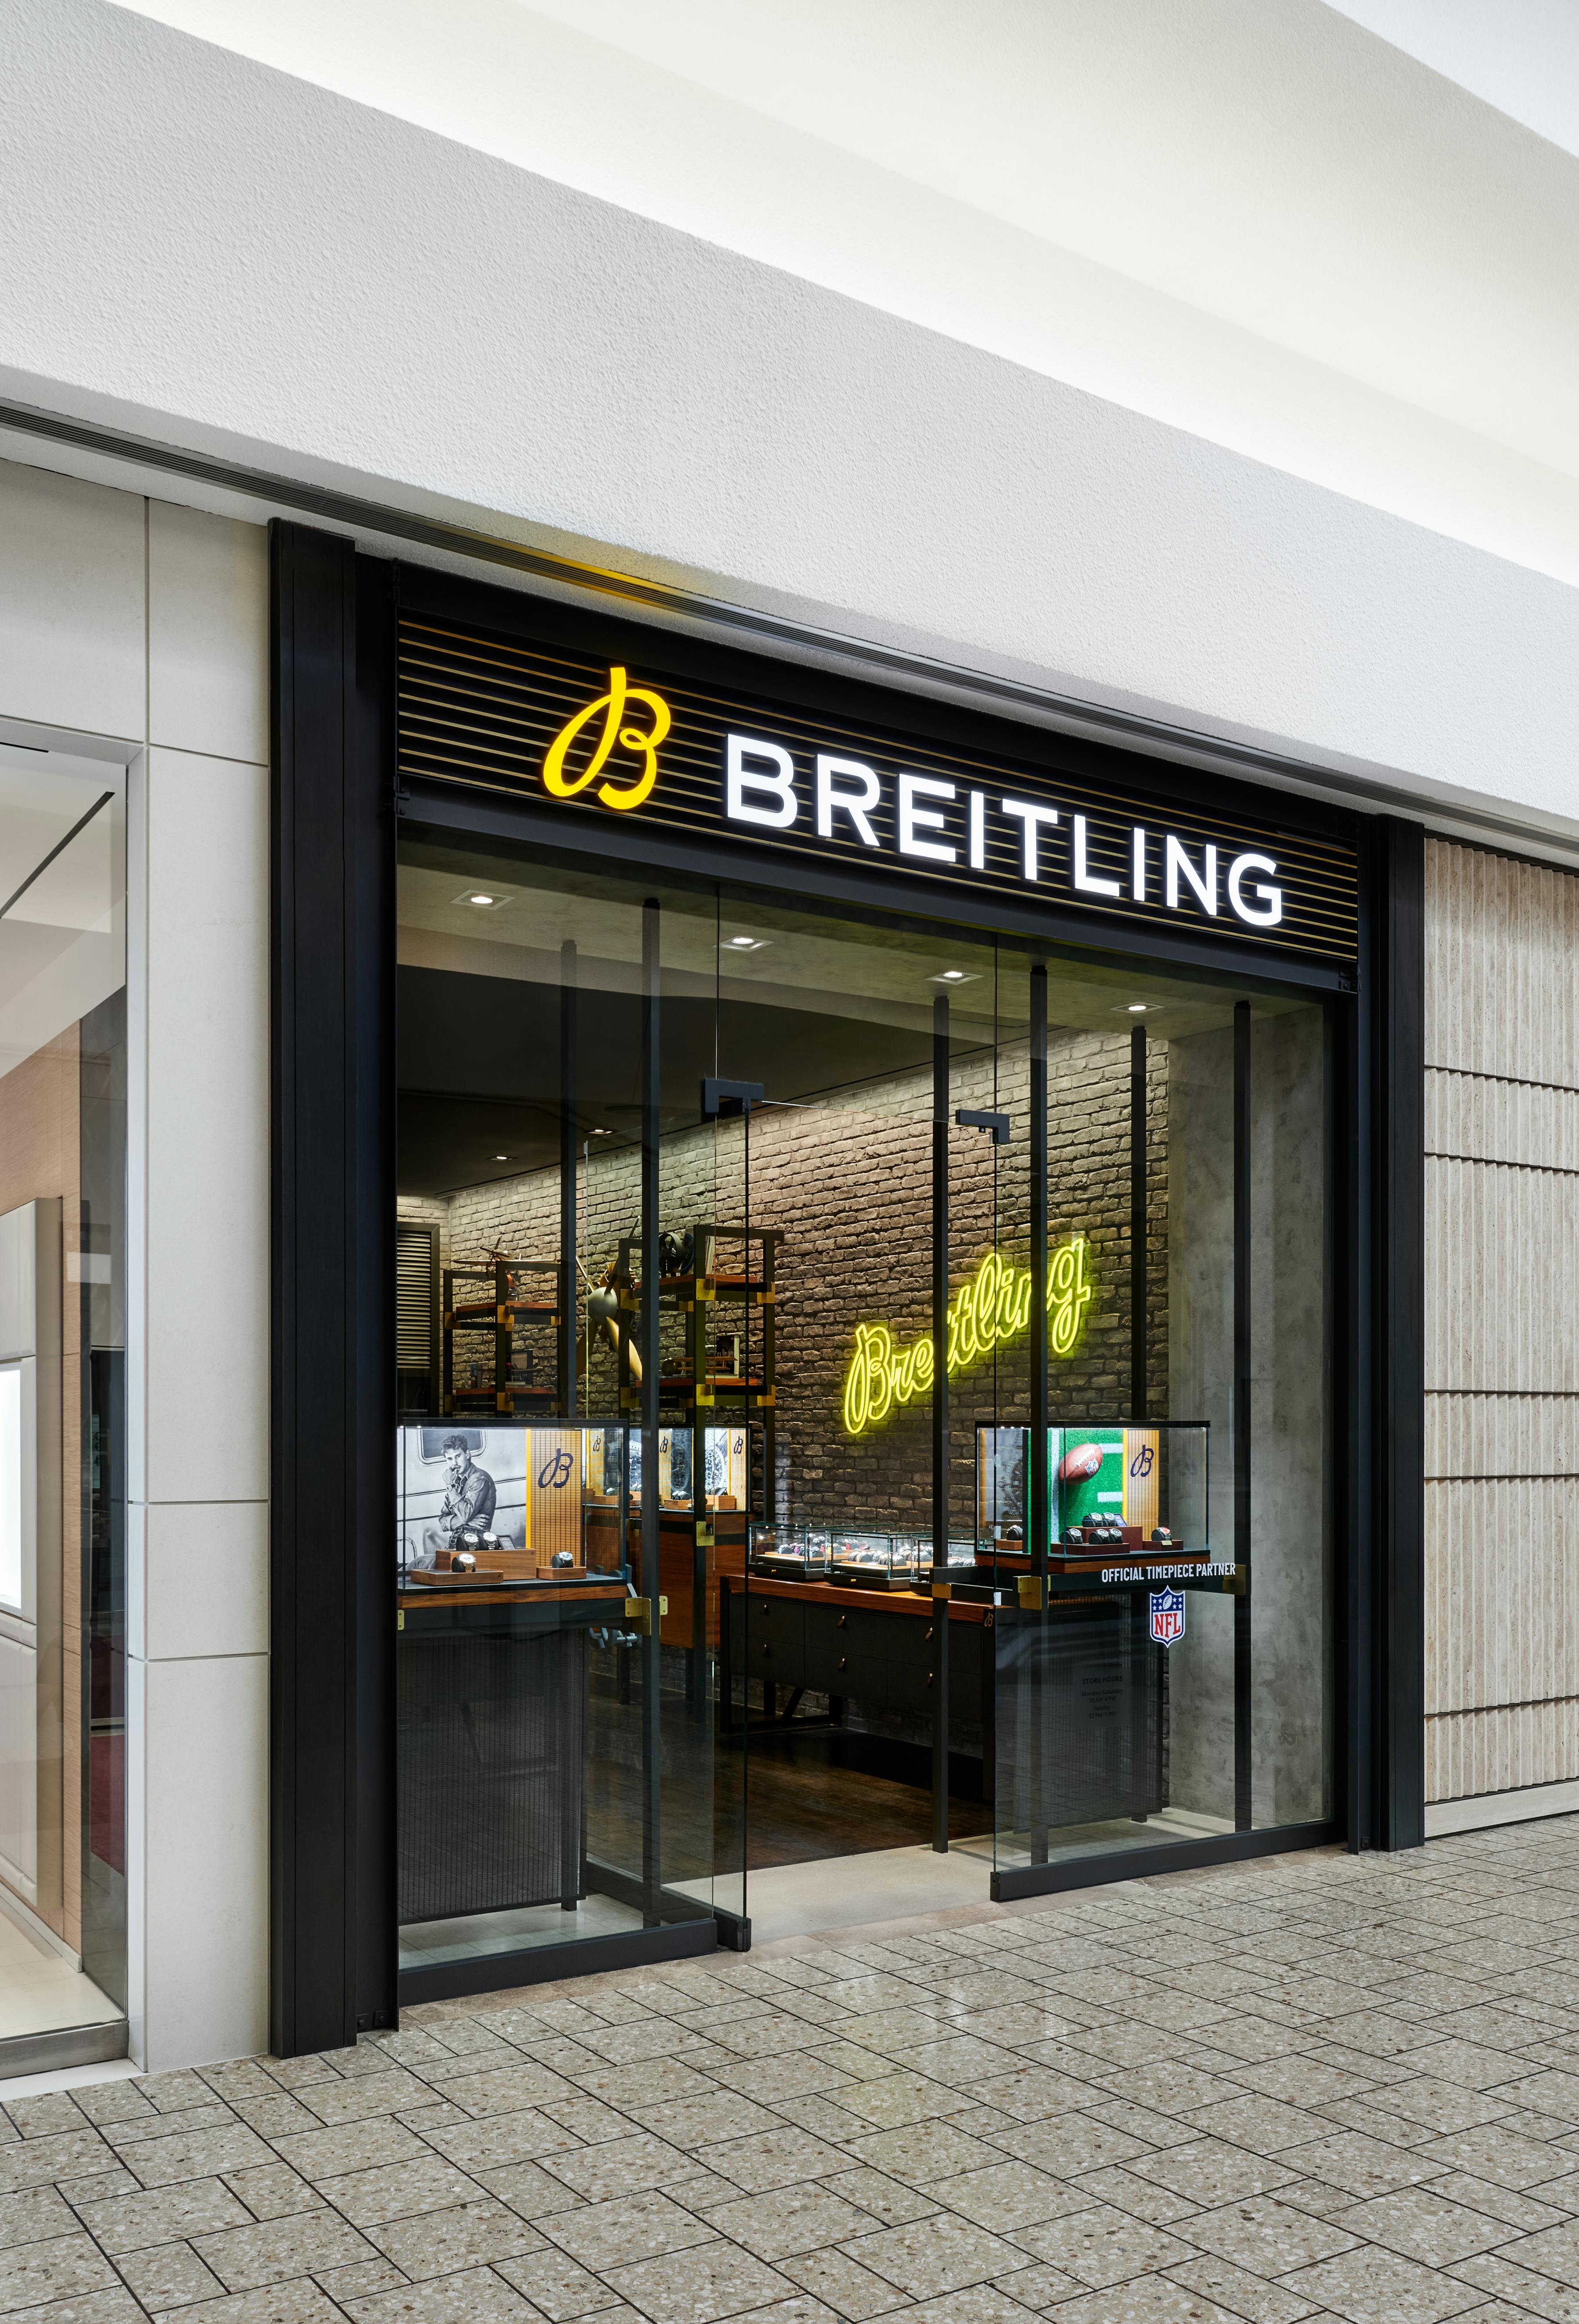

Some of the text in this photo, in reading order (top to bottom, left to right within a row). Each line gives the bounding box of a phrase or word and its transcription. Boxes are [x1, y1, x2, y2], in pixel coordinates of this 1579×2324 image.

[726, 733, 1282, 927] BREITLING
[845, 1238, 1091, 1434] Bretlig
[1102, 1562, 1236, 1583] OFFICIAL TIMEPIECE PARTNER
[1154, 1613, 1181, 1638] NFL
